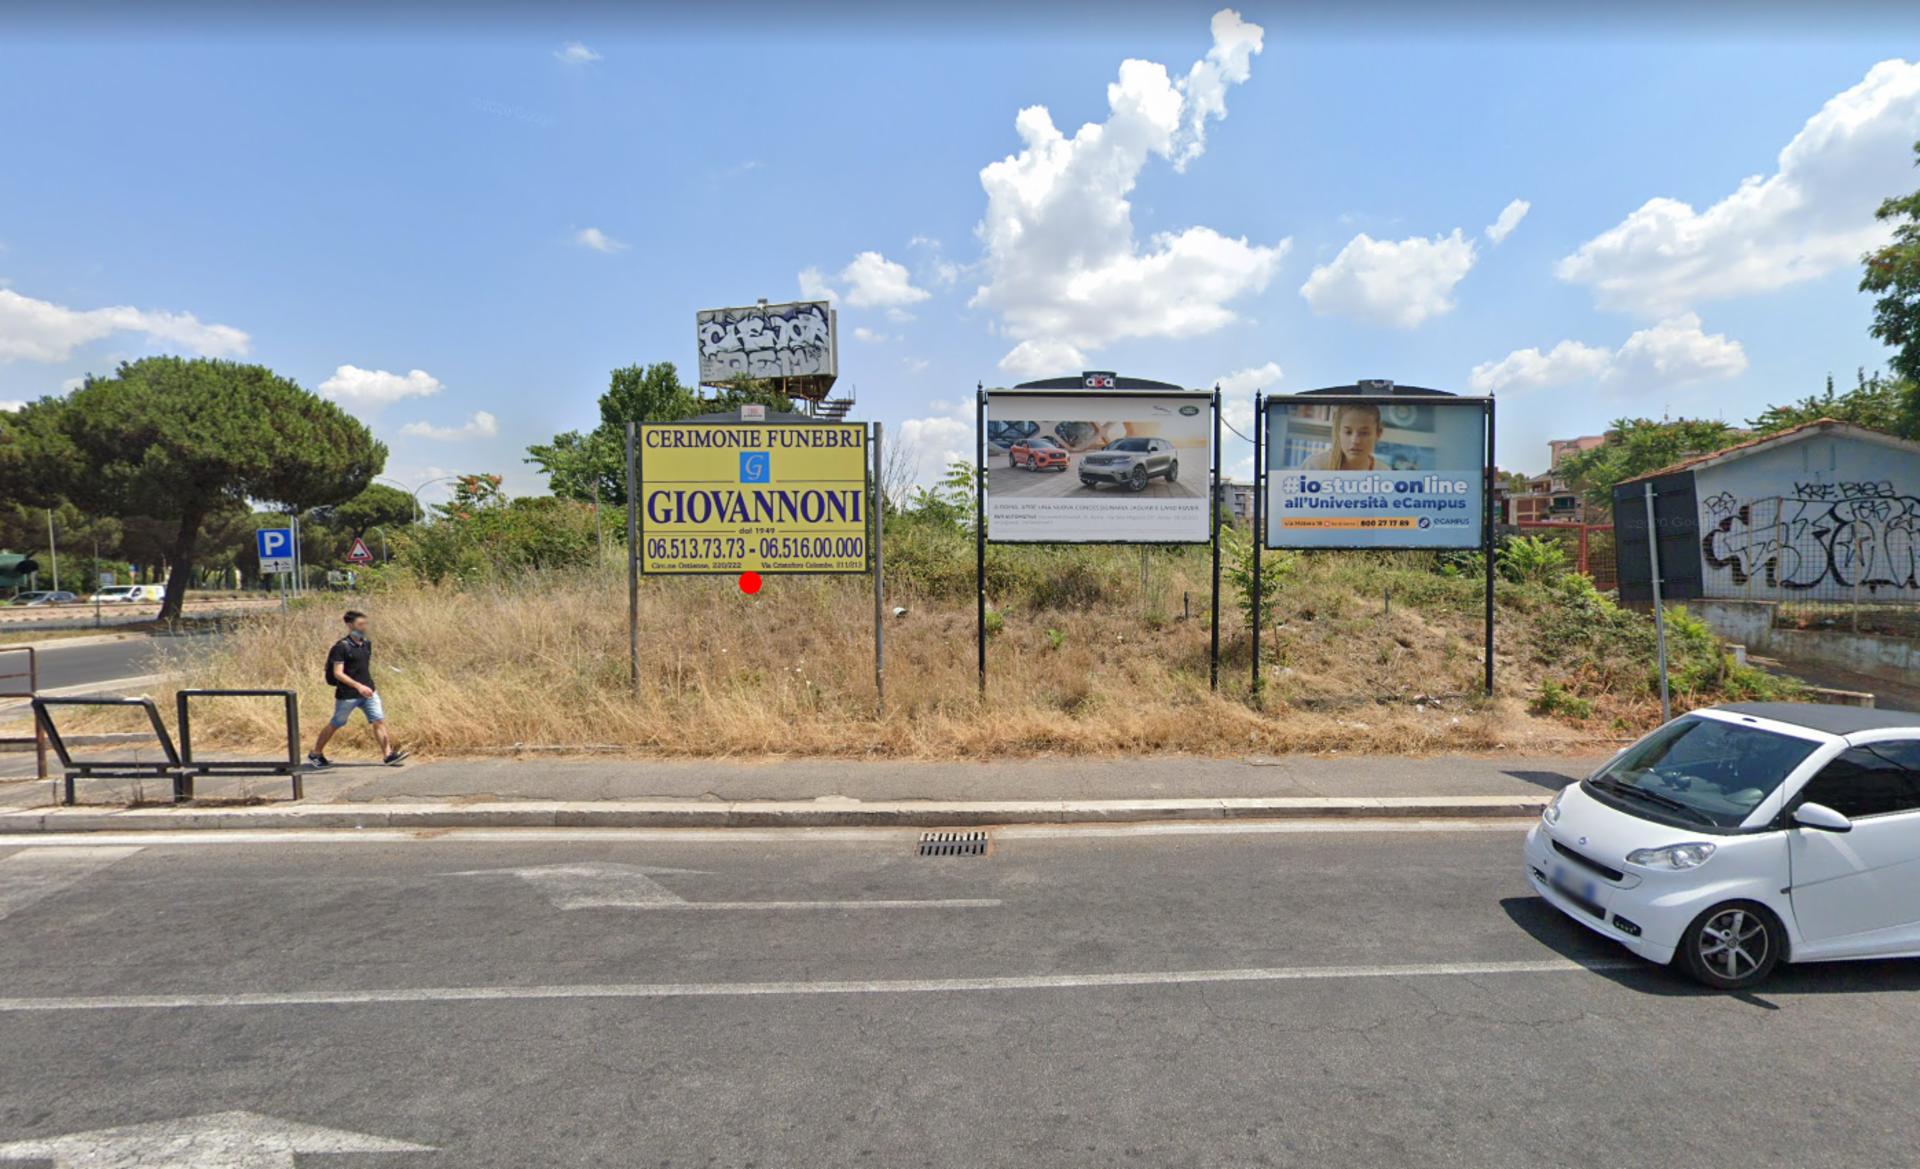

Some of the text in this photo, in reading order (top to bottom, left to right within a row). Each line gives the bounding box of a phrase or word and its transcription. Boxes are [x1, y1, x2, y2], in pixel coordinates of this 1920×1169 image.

[646, 429, 862, 448] CERIMONIE FUNEBRI
[745, 454, 764, 480] G
[1282, 476, 1468, 495] #iostudioonline
[647, 490, 862, 524] GIOVANNONI
[1284, 496, 1466, 511] all'Università eCampus
[1361, 519, 1376, 527] 800
[1378, 519, 1387, 527] 27
[1389, 519, 1397, 527] 17
[263, 531, 285, 555] P
[648, 538, 745, 559] 06.513.73.73
[759, 537, 863, 559] 06.516.00.000
